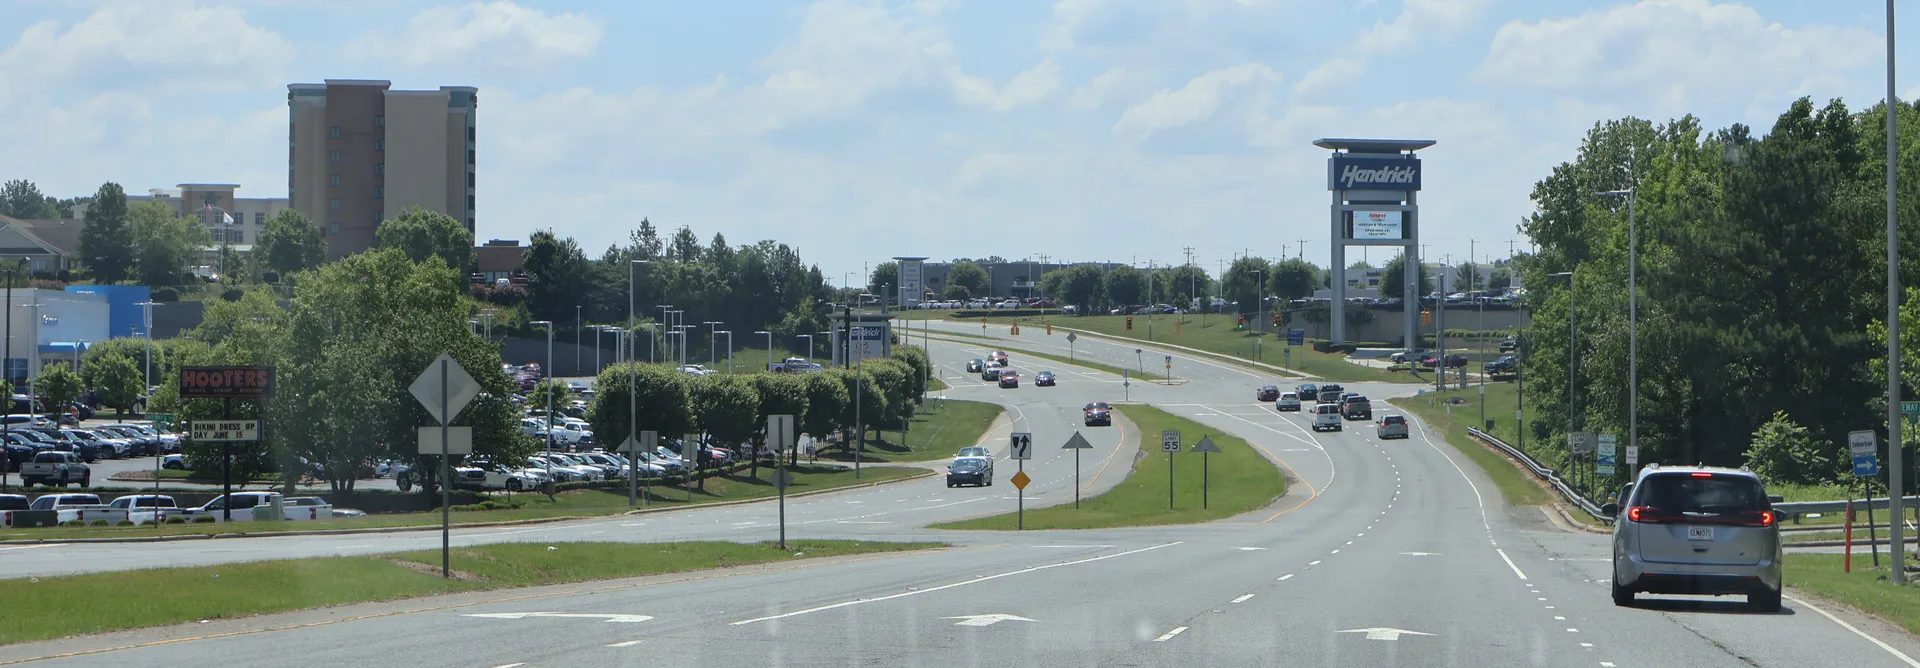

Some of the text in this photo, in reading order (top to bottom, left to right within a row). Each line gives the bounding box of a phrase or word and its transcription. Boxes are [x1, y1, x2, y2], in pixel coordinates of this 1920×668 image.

[1340, 165, 1416, 188] Hendrick
[182, 370, 268, 388] HOOTERS
[194, 431, 243, 439] DAY JUNE 15
[1164, 441, 1179, 450] 55
